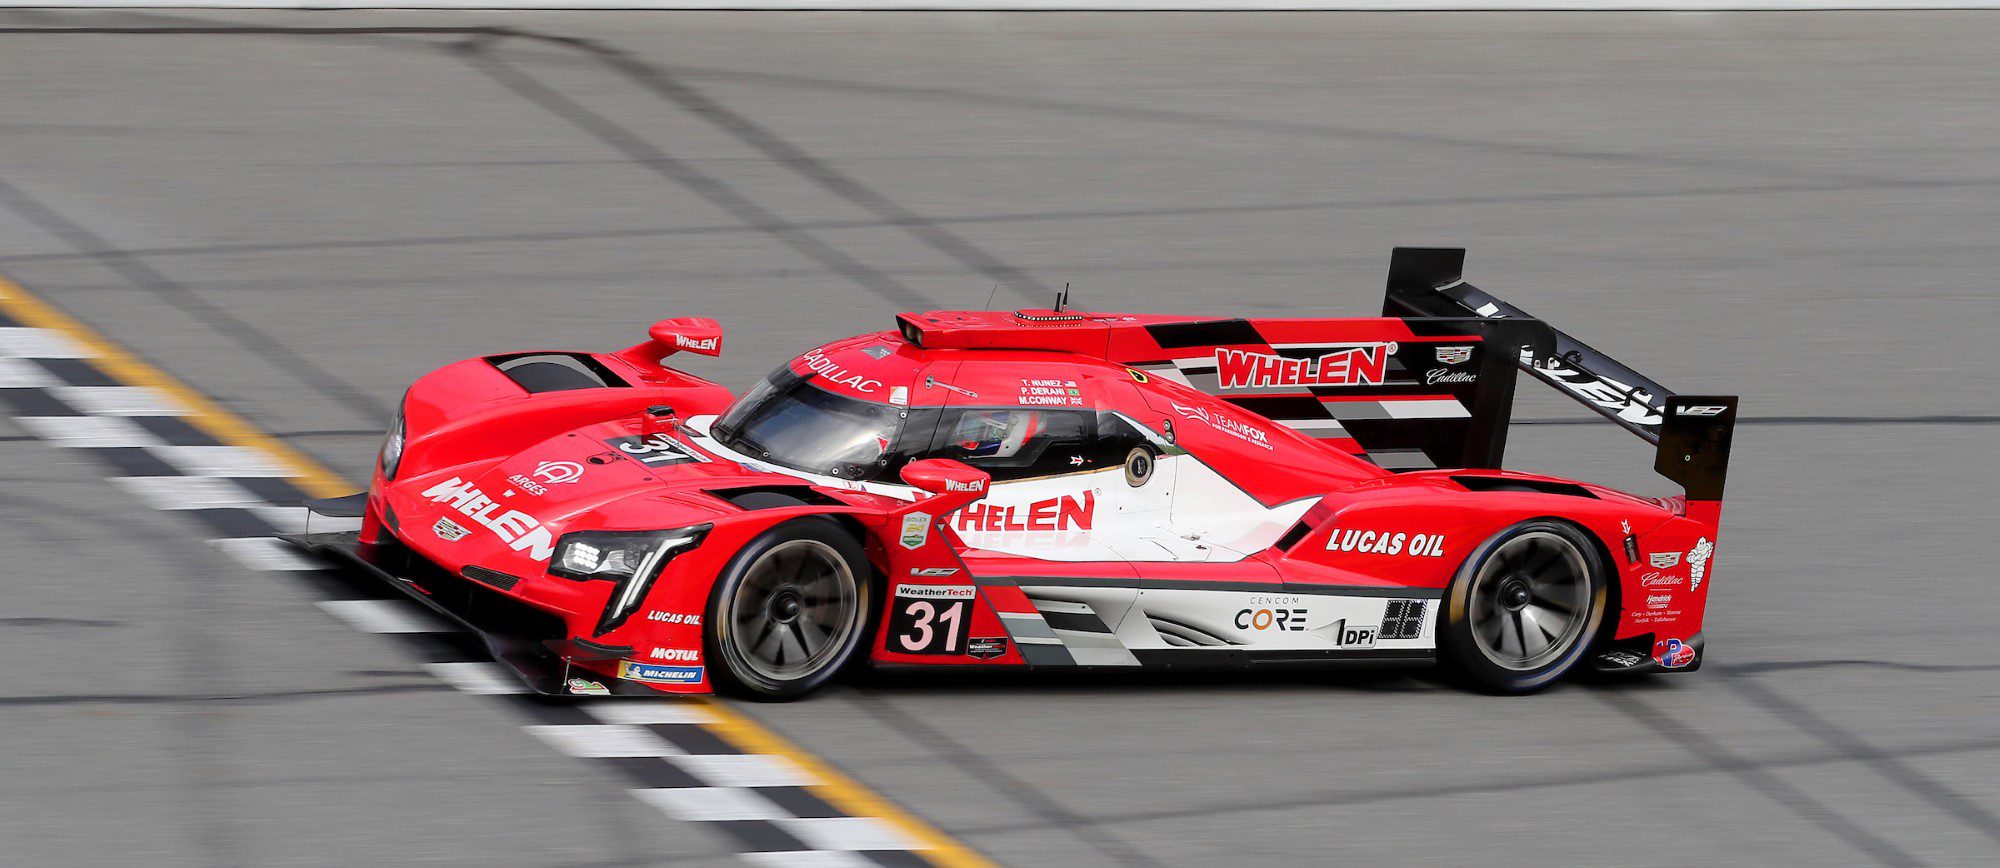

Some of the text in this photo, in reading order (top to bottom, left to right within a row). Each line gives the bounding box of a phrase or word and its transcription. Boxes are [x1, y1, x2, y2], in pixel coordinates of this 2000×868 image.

[675, 334, 718, 350] WHELEN
[803, 348, 883, 393] CADILLAC
[1426, 368, 1477, 385] Cadillac
[1020, 387, 1066, 395] P. DERANI
[1031, 379, 1062, 387] NUNEZ
[619, 439, 690, 463] 31
[508, 473, 548, 497] ARGES
[944, 477, 985, 492] WHELEN
[943, 489, 1095, 531] HELEN
[421, 477, 556, 562] WHELEN
[1325, 528, 1445, 557] LUCAS OIL
[1641, 572, 1683, 588] Cadillac
[900, 586, 973, 596] WeatherTech
[1250, 596, 1300, 605] CENCOM
[647, 610, 701, 625] LUCAS OIL
[899, 600, 963, 651] 31
[1234, 608, 1308, 631] CORE
[1345, 629, 1375, 646] DPi
[650, 647, 699, 661] MOTUL
[642, 669, 697, 679] MICHELIN
